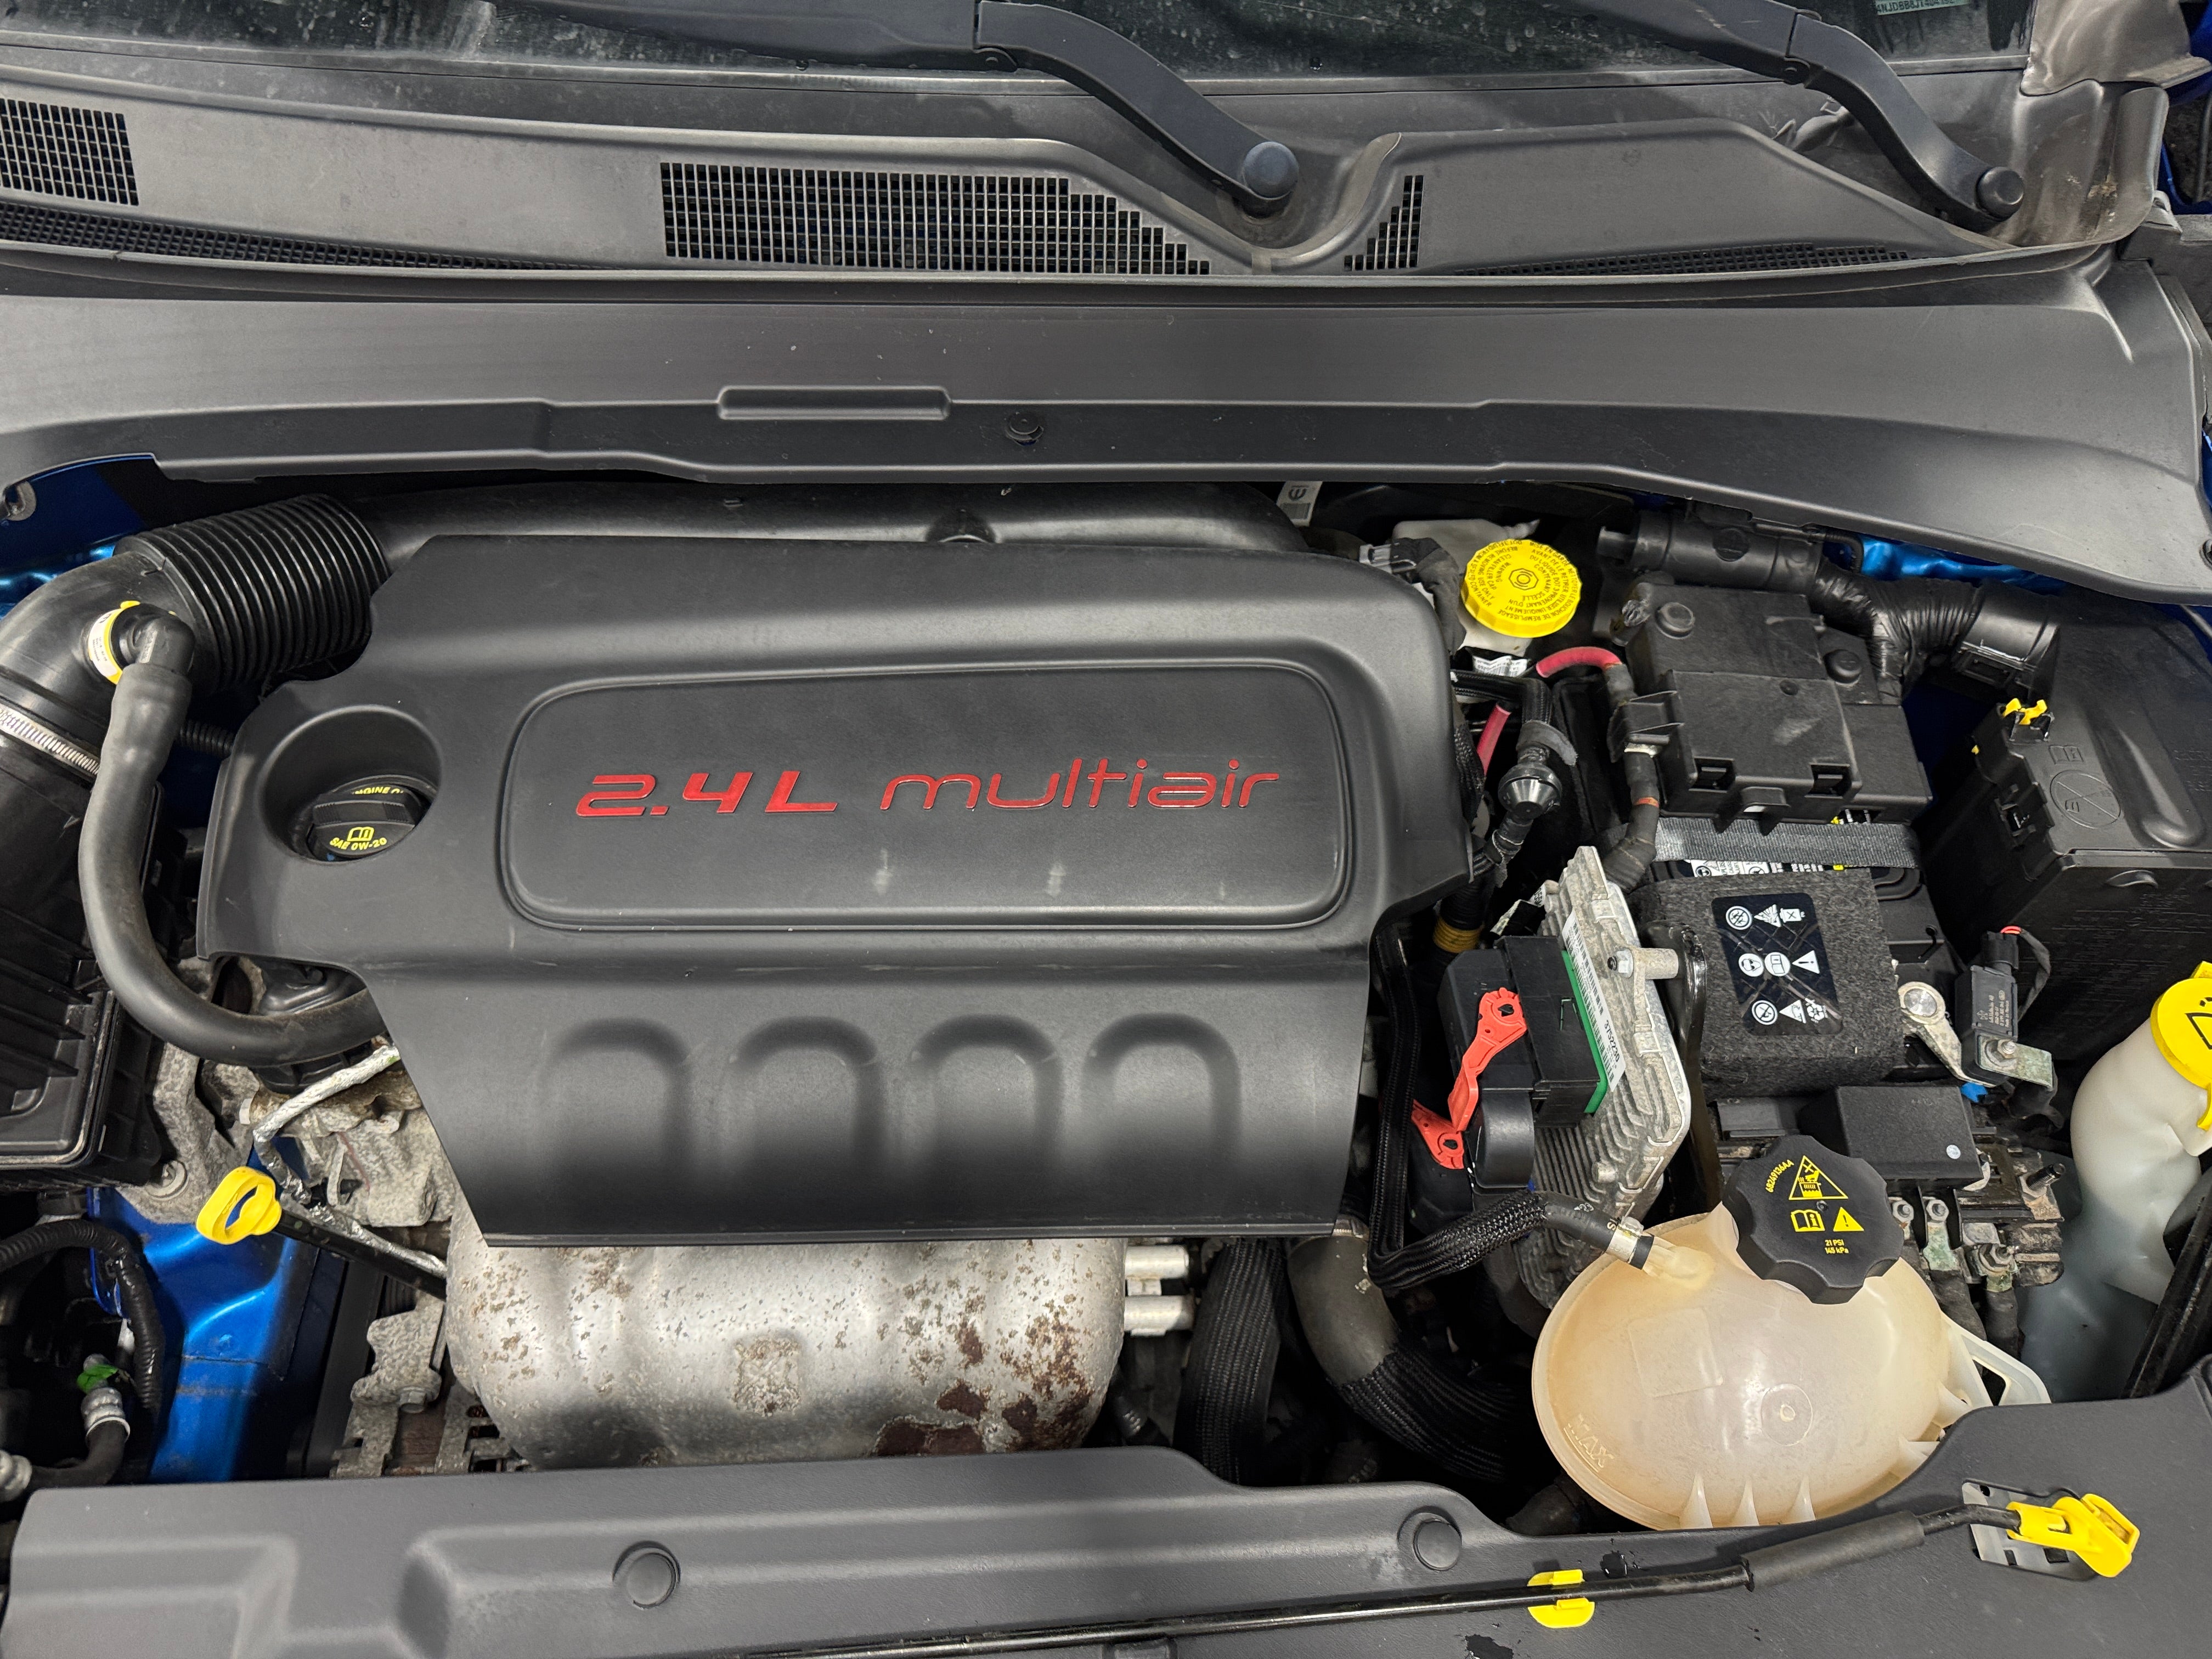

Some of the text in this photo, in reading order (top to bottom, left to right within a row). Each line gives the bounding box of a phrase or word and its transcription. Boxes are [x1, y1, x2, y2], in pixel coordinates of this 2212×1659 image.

[1470, 582, 1492, 607] CONTAINER
[1482, 587, 1496, 600] ONLY
[1487, 580, 1497, 590] CAP
[1497, 610, 1541, 622] REMPLISSAGE
[879, 758, 1280, 811] multiair
[330, 837, 387, 851] SAE 0W-20
[1604, 1019, 1621, 1063] 3752230
[1765, 1159, 1795, 1193] 68249136AA
[1567, 1414, 1615, 1469] MAX
